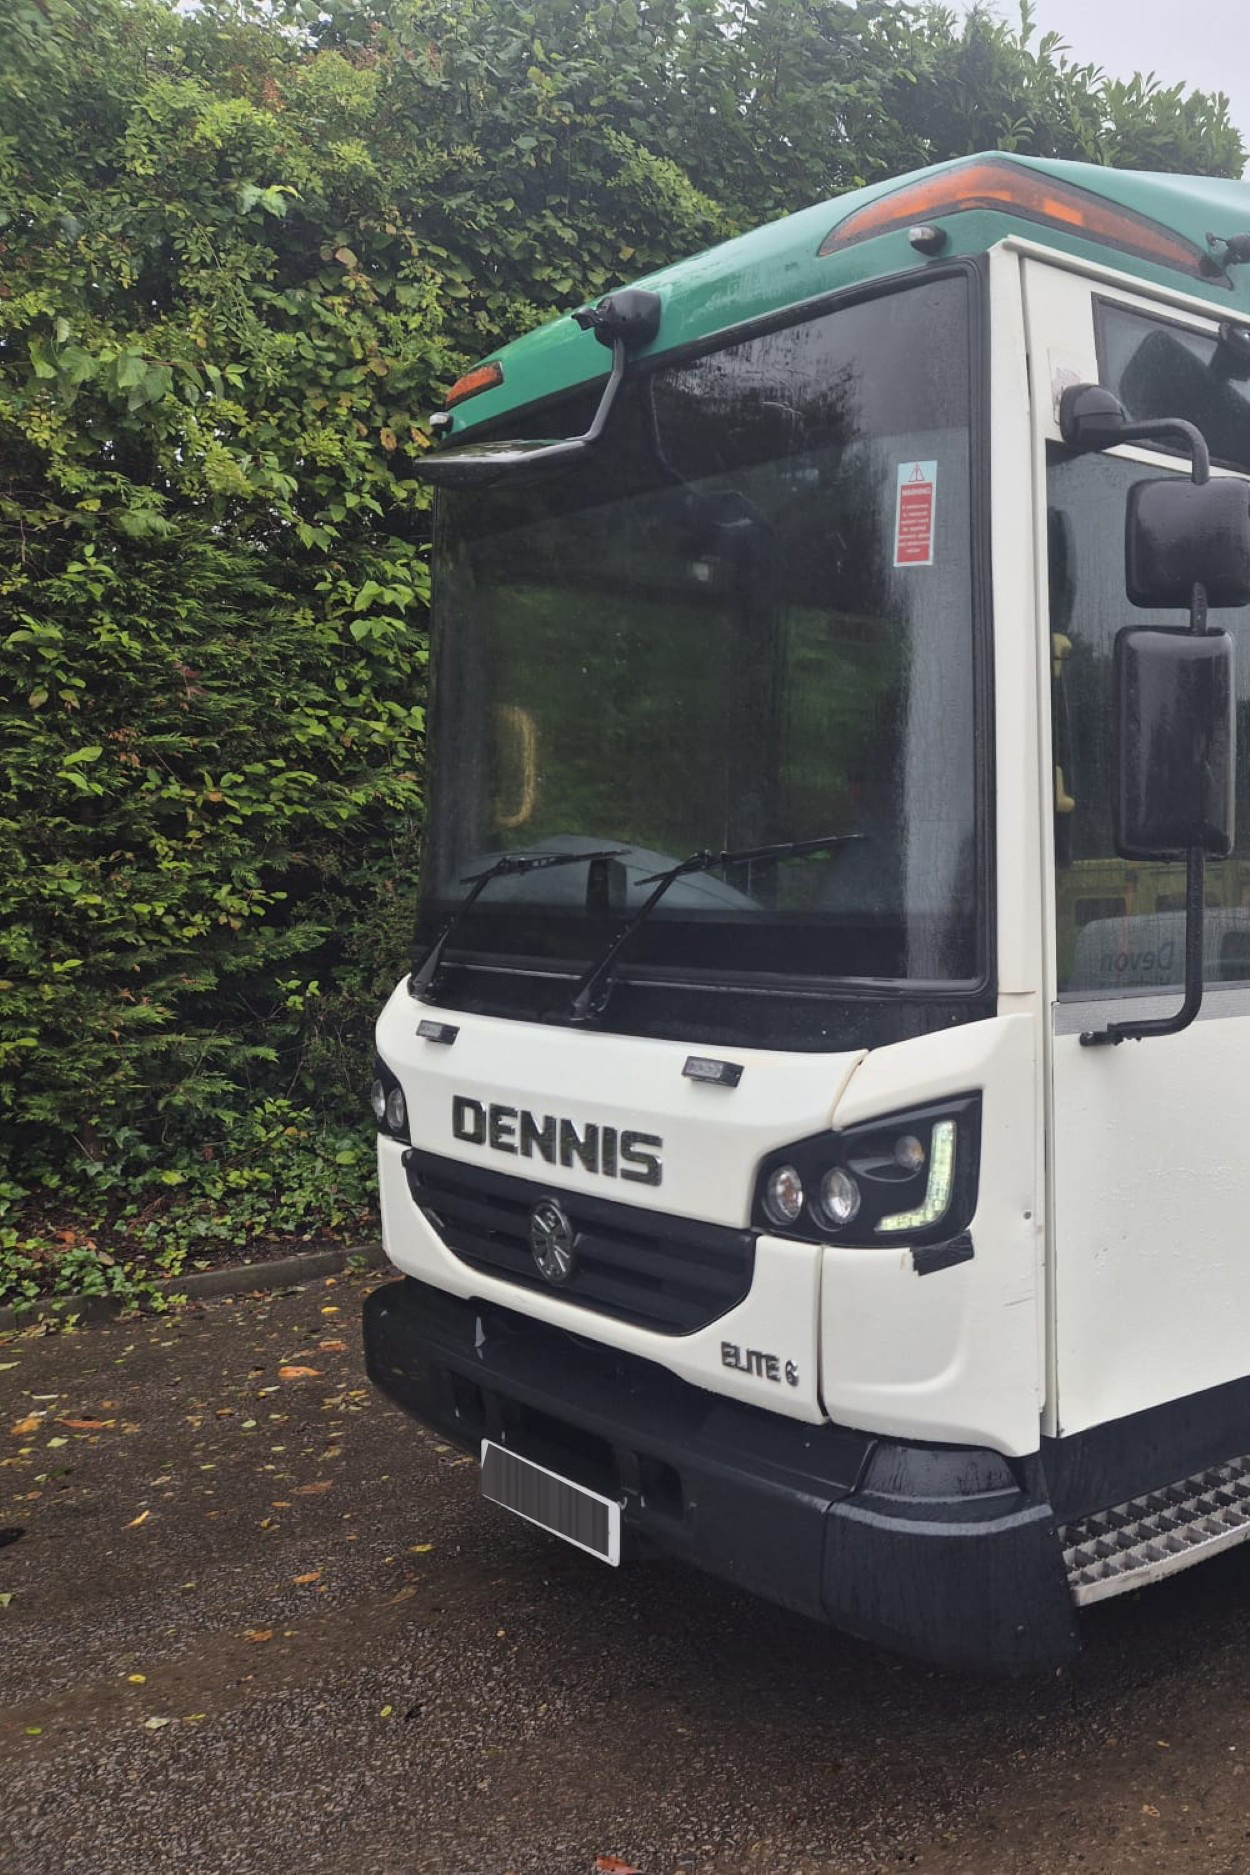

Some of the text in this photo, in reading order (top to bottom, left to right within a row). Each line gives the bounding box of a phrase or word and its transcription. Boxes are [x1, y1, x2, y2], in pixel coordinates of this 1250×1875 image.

[453, 1094, 663, 1187] DENNIS
[721, 1340, 800, 1388] ELITE 6
